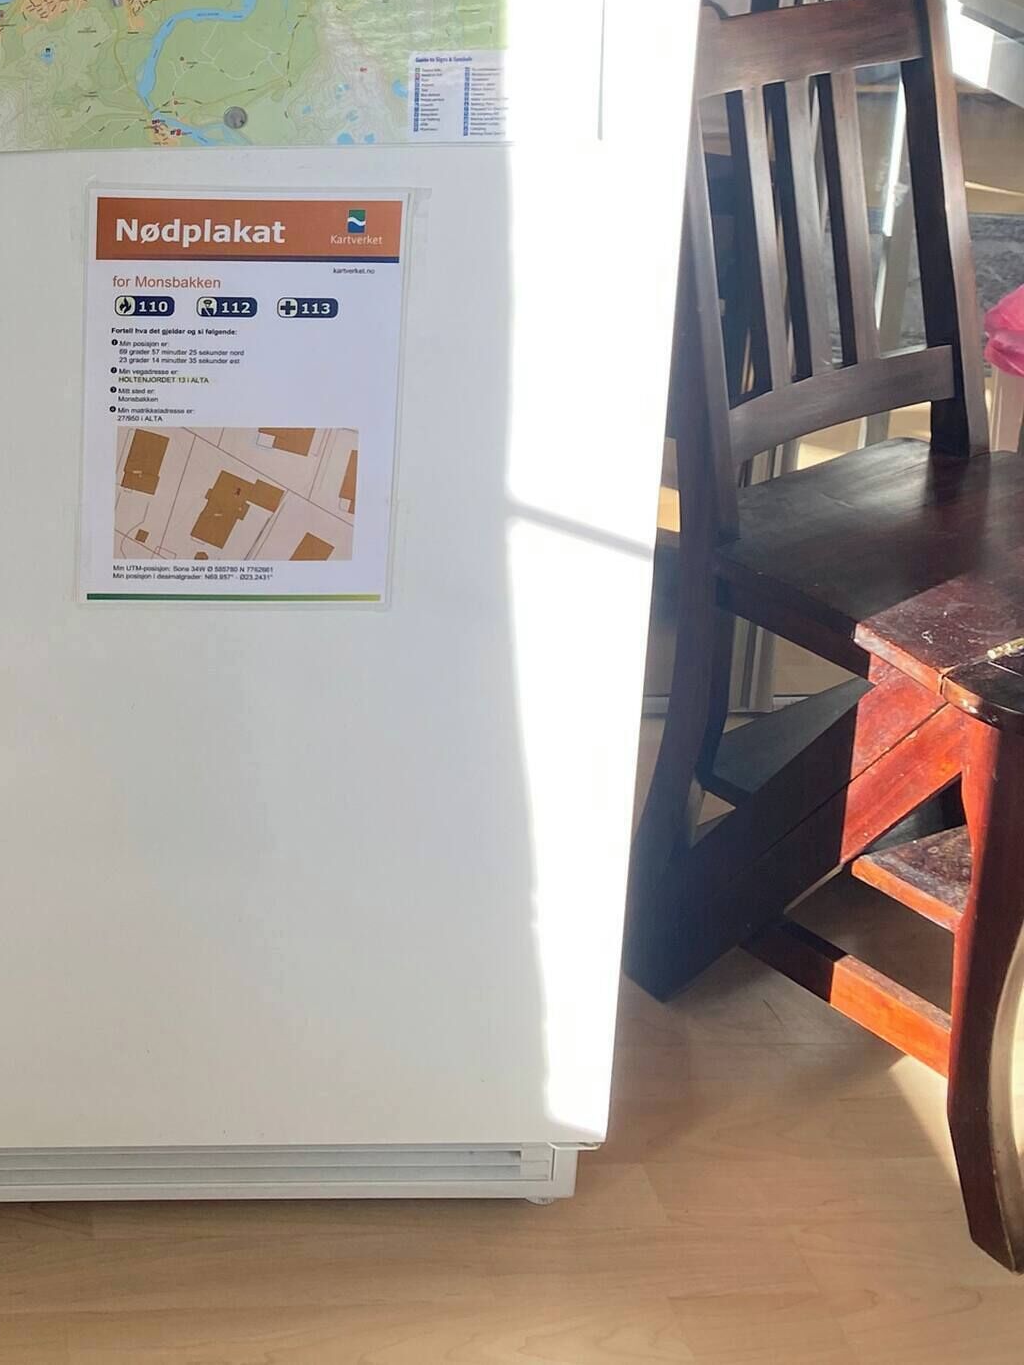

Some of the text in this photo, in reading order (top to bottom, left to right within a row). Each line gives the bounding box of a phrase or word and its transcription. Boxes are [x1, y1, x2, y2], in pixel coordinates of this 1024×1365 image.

[115, 218, 286, 247] Nødplakat
[330, 234, 383, 245] Kartverket
[112, 275, 221, 289] for Monsbakken
[139, 302, 168, 312] 110
[221, 302, 251, 313] 112
[301, 303, 331, 314] 113
